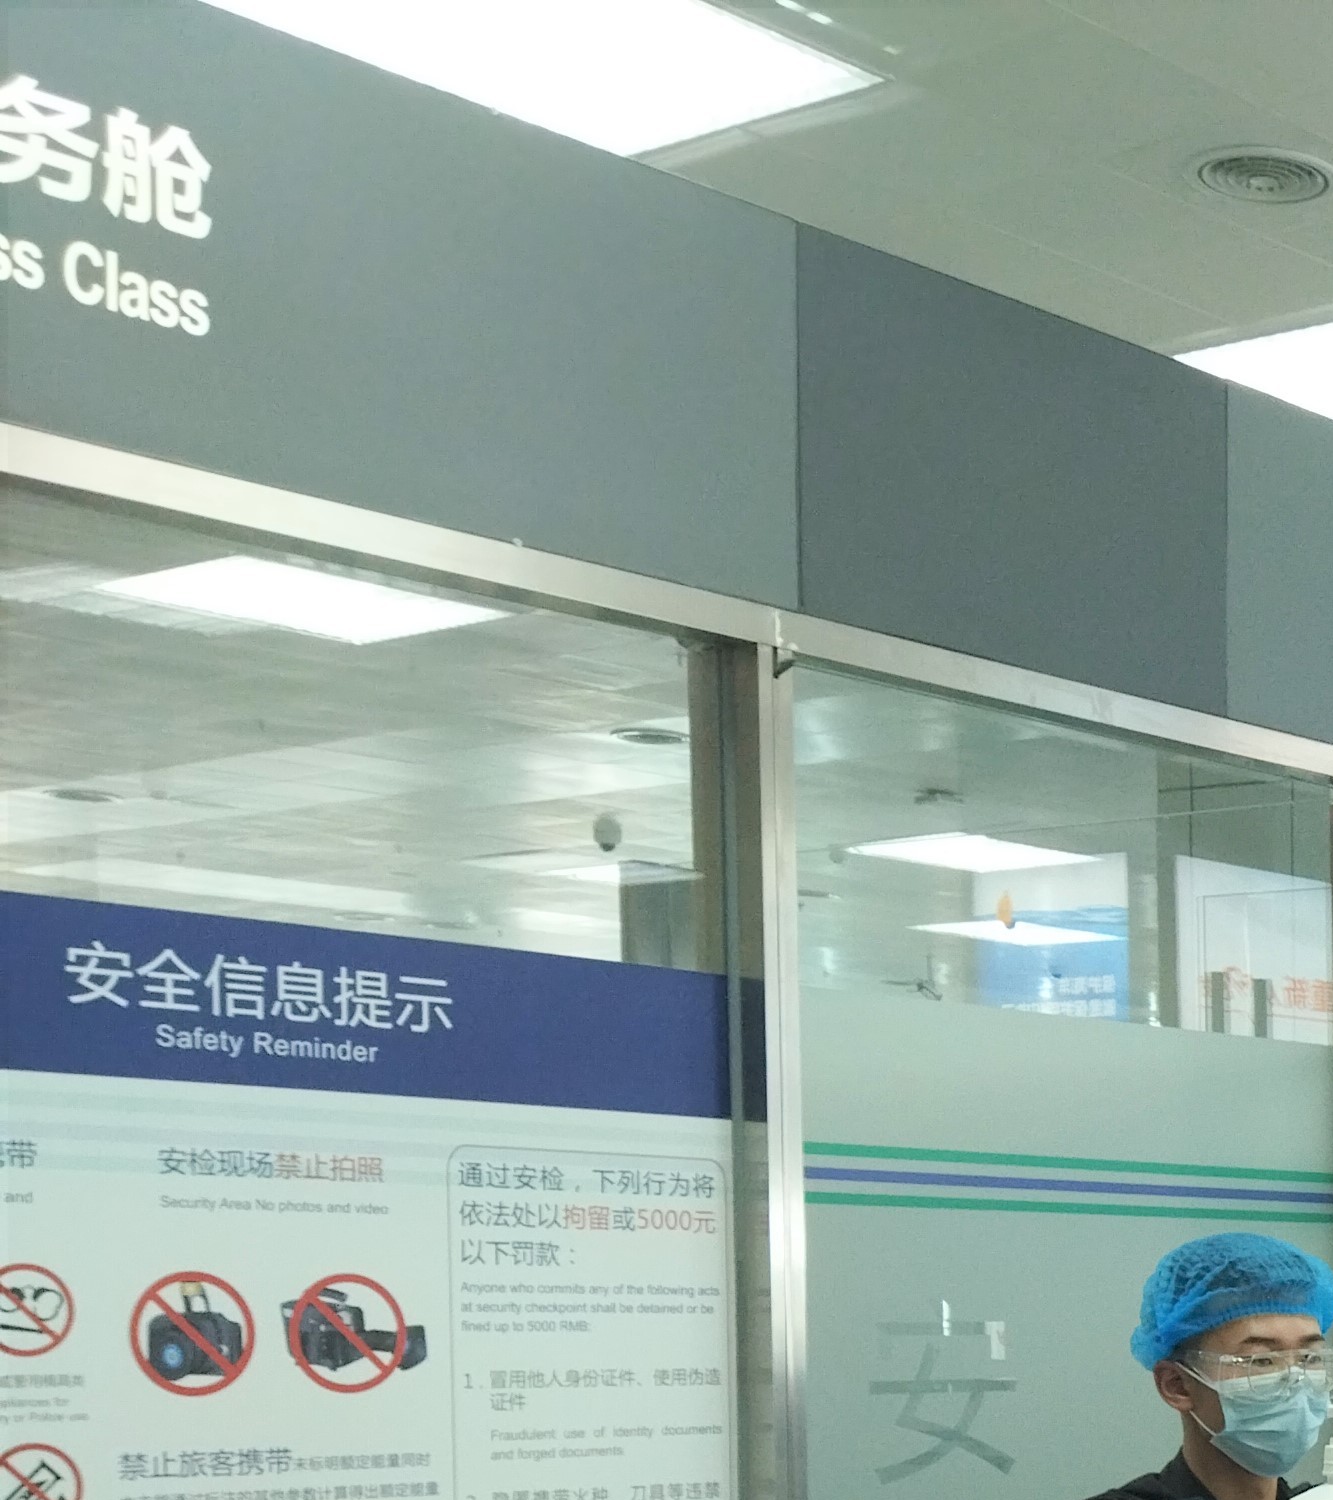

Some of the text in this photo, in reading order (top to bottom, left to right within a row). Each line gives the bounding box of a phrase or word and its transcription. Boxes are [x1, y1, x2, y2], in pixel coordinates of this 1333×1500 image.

[63, 240, 211, 336] Class
[64, 941, 453, 1033] 安全信息提示
[155, 1023, 379, 1063] Safety Reminder
[157, 1147, 384, 1183] 安检现场禁止拍照
[458, 1161, 715, 1199] 通过安检，下列行为将
[6, 1191, 33, 1204] and
[160, 1195, 389, 1215] Security Area No photos and video
[459, 1201, 716, 1234] 依法处以拘留或5000元
[461, 1239, 576, 1266] 以下罚款：
[461, 1282, 720, 1298] Anyone who commits any of the following acts
[461, 1302, 714, 1316] at security checkpoint shall be detained or be
[461, 1322, 490, 1333] fined
[494, 1324, 509, 1335] up
[512, 1322, 524, 1333] to
[527, 1321, 556, 1333] 5000
[490, 1424, 723, 1441] Fraudulent use of identity documents
[490, 1449, 514, 1461] and
[517, 1448, 556, 1462] forged
